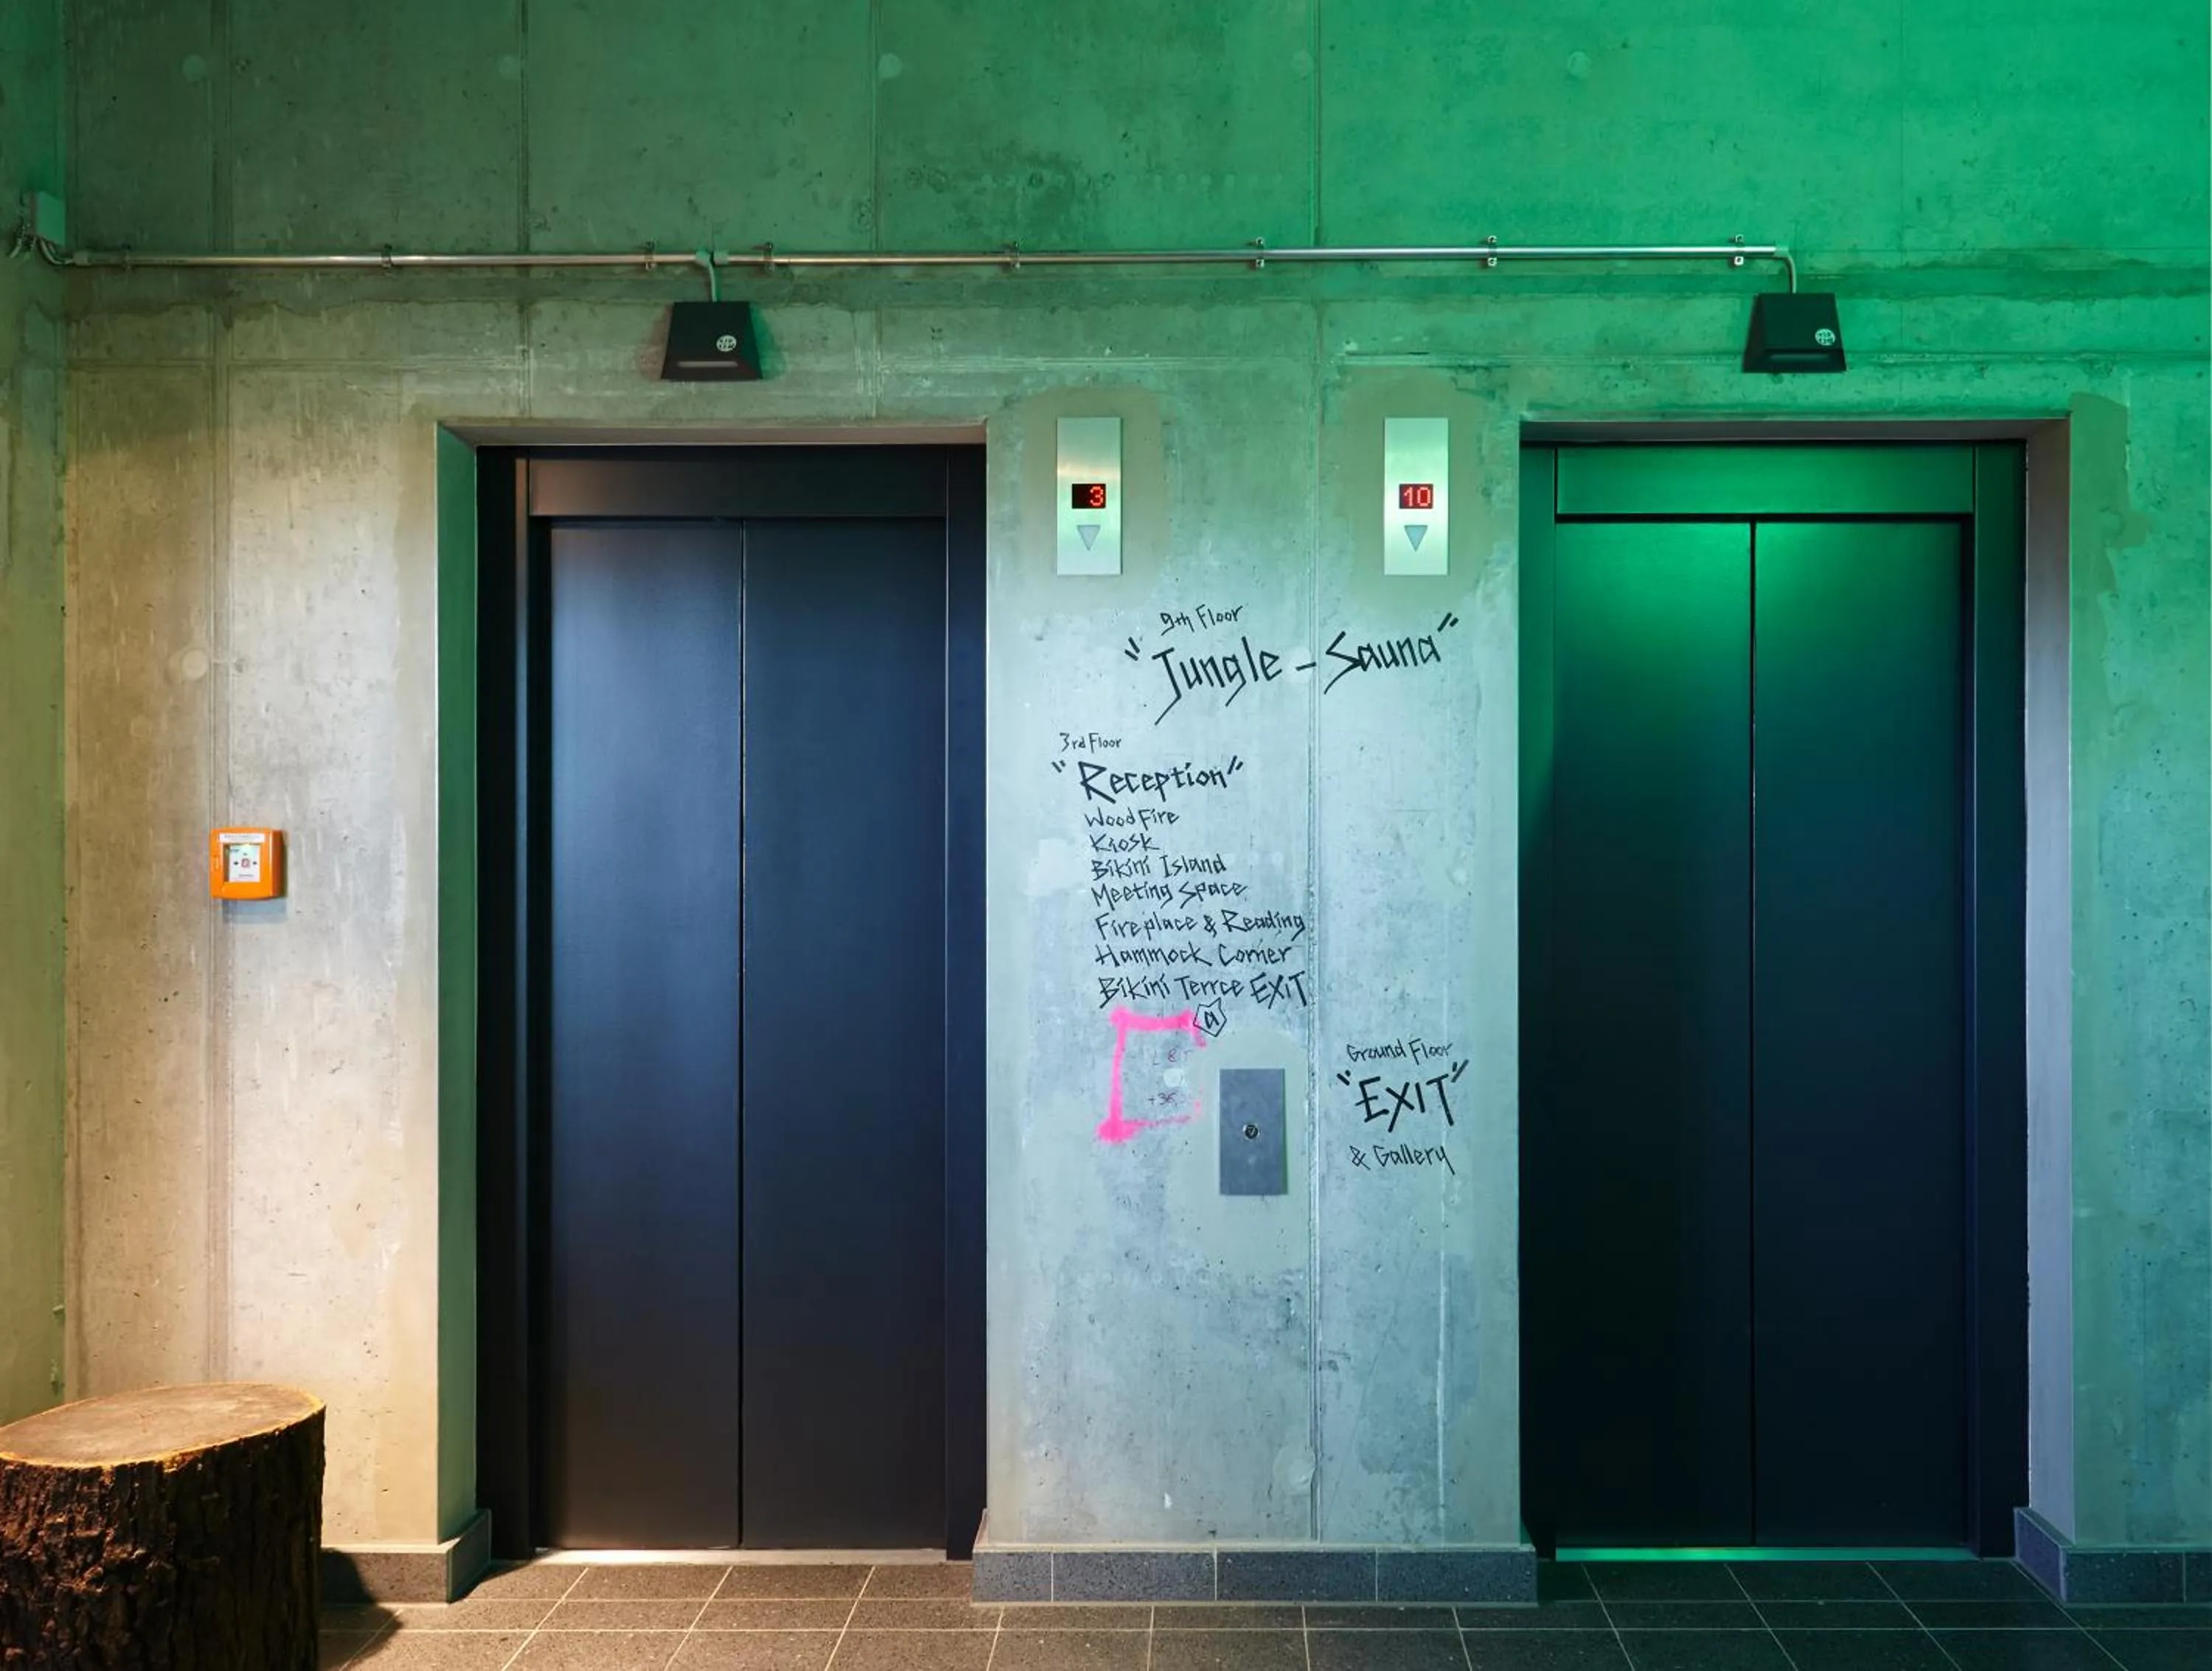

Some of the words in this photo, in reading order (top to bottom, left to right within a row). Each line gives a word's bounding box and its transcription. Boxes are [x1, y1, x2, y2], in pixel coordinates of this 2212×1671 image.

[1090, 486, 1104, 506] 3
[1404, 487, 1431, 507] 10
[1160, 612, 1194, 636] 9th
[1195, 604, 1243, 629] Floor
[1060, 732, 1086, 751] 3rd
[1088, 732, 1121, 754] Floor
[1085, 807, 1135, 827] Wood
[1138, 808, 1180, 831] Fire
[1089, 833, 1159, 852] Kiosk
[1091, 855, 1151, 880] Bikini
[1159, 852, 1227, 878] Island
[1091, 881, 1174, 911] Meeting
[1179, 880, 1248, 909] Space
[1095, 911, 1197, 941] Fireplace
[1203, 914, 1217, 938] &
[1220, 909, 1306, 941] Reading
[1094, 941, 1213, 967] Hammock
[1217, 942, 1292, 967] Corner
[1098, 973, 1170, 1009] Bikini
[1174, 975, 1245, 1000] Terrce
[1346, 1038, 1408, 1063] Ground
[1408, 1038, 1453, 1066] Floor
[1349, 1145, 1371, 1171] &
[1372, 1144, 1455, 1175] Gallery
